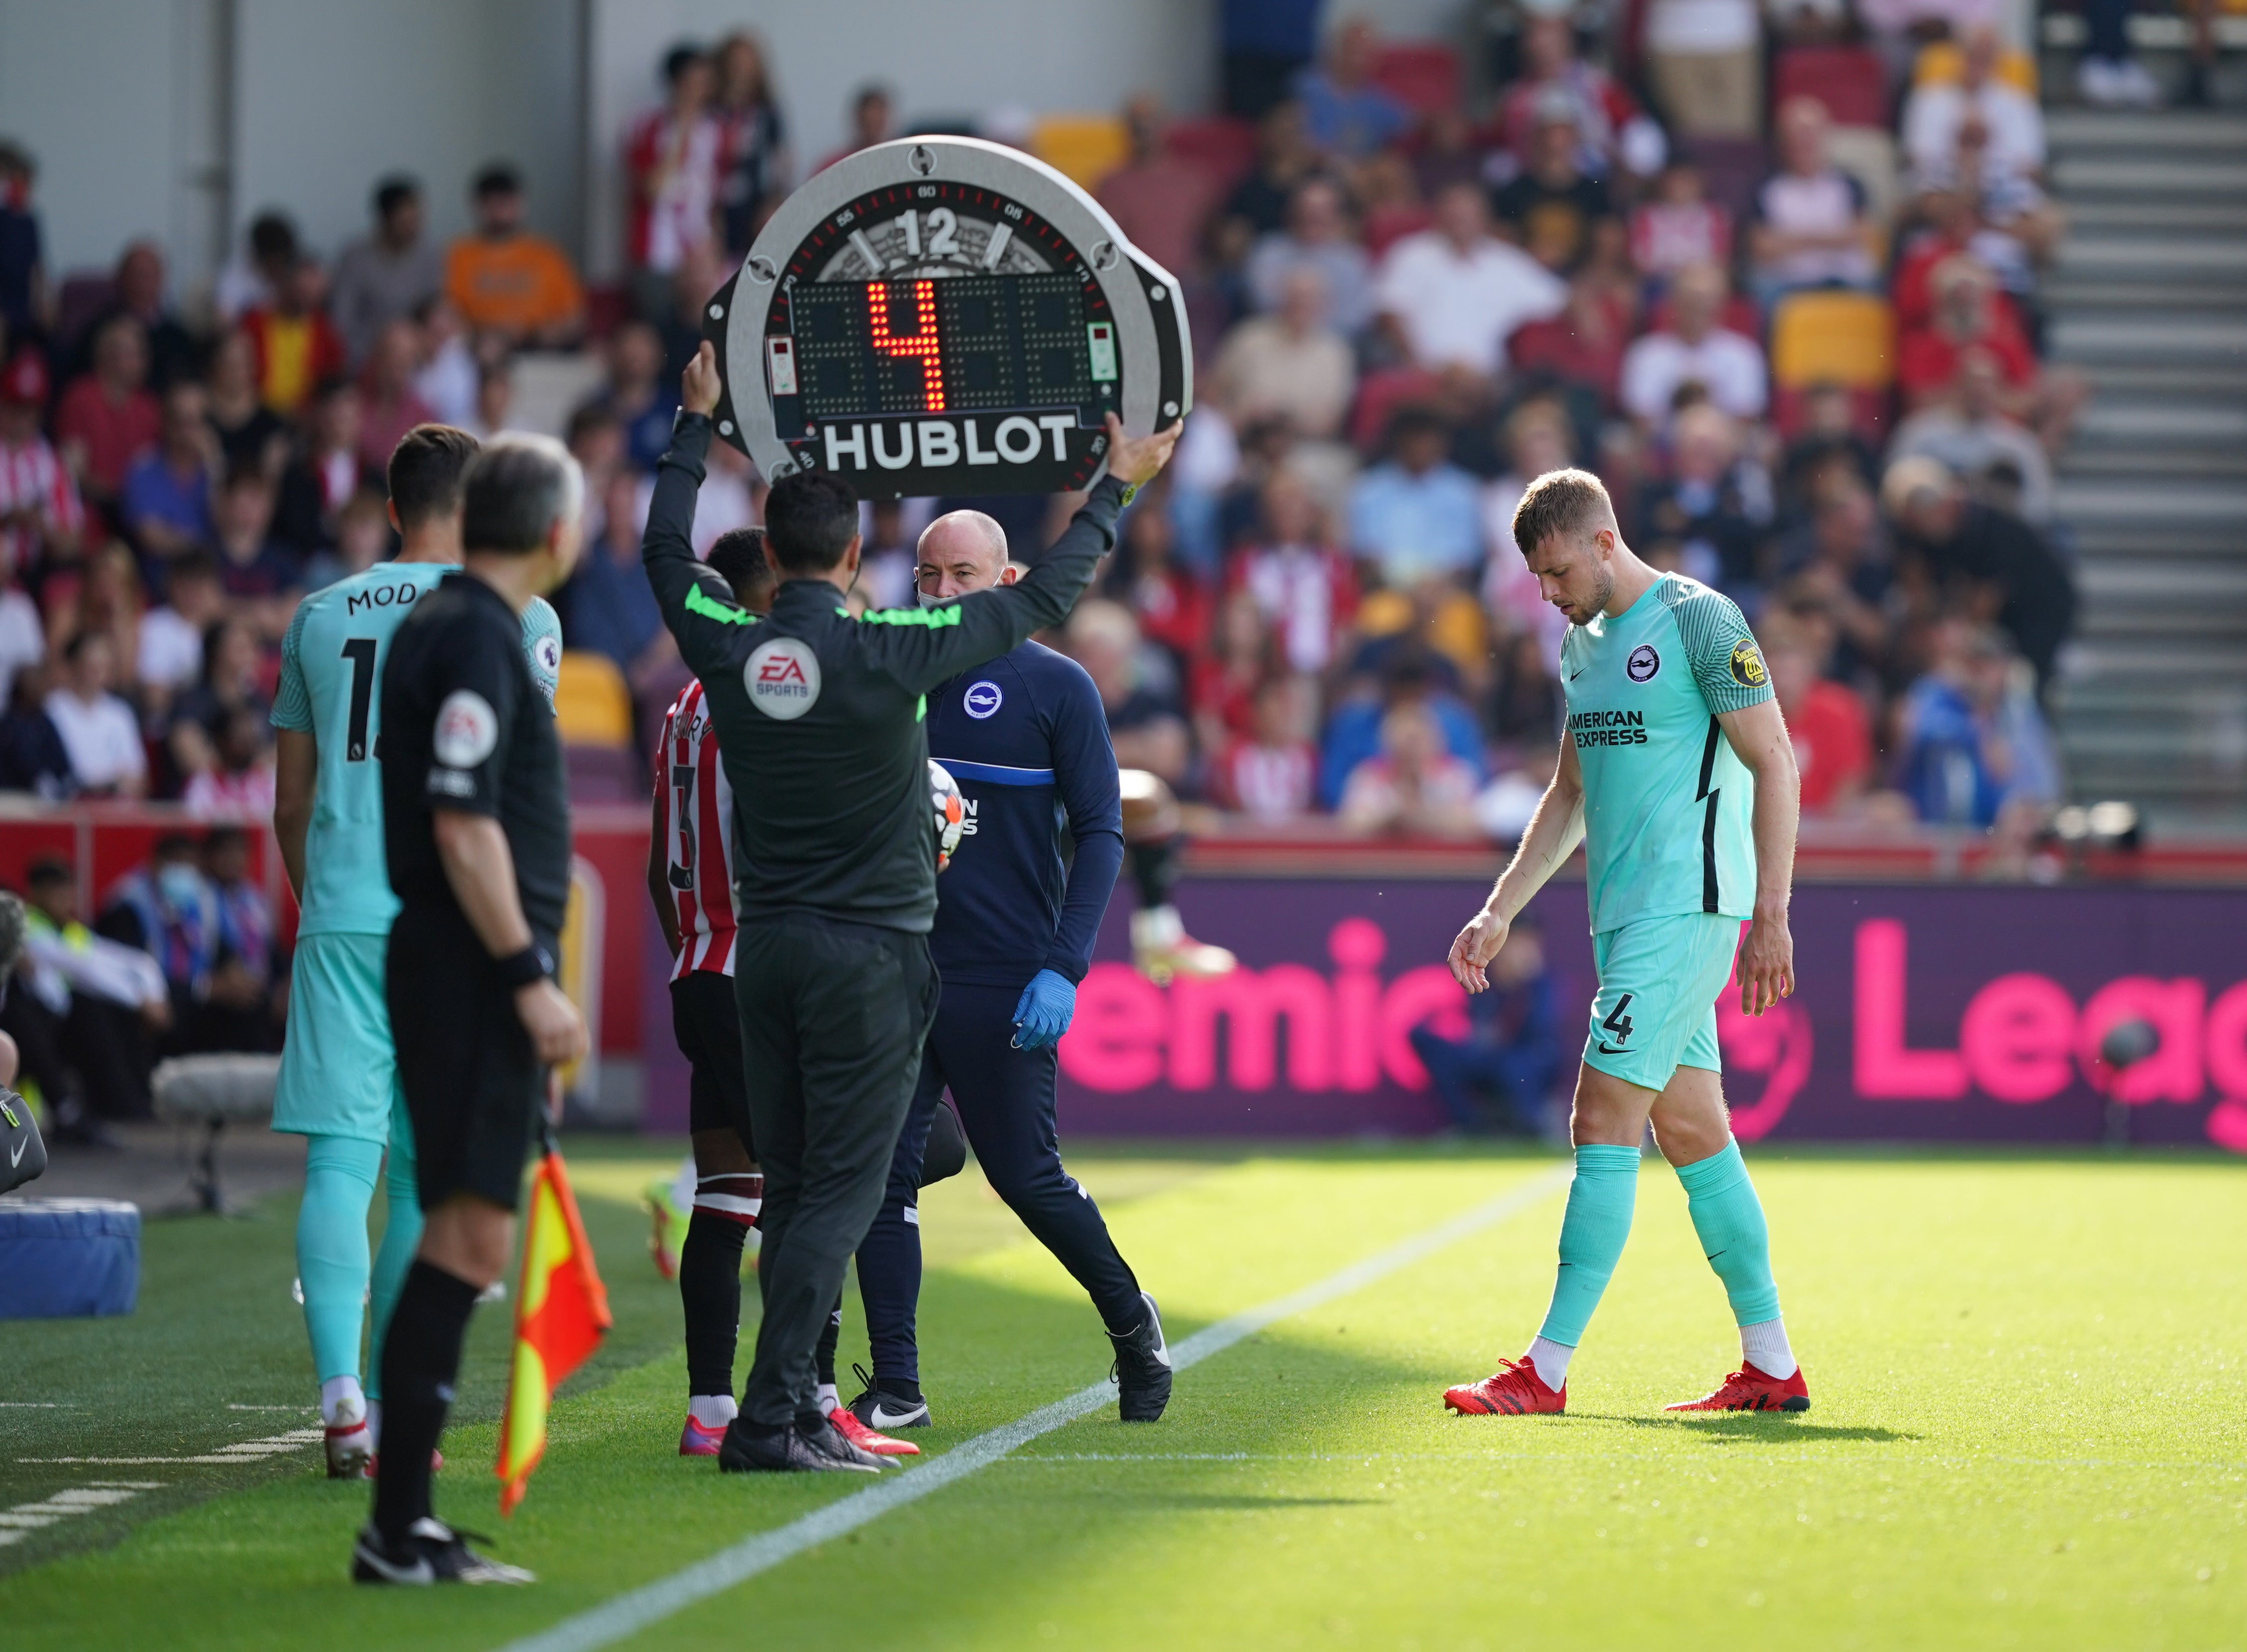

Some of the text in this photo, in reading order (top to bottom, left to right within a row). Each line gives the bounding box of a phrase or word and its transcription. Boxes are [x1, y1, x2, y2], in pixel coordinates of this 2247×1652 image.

[917, 185, 937, 198] 60
[836, 211, 854, 226] 55
[1004, 203, 1023, 220] 05
[895, 207, 960, 257] 12
[867, 280, 944, 412] 4
[824, 414, 1076, 471] HUBLOT
[347, 583, 432, 616] MOD
[758, 656, 806, 685] EA
[340, 638, 382, 762] 1
[756, 683, 809, 699] SPORTS
[1568, 711, 1644, 730] AMERICAN
[1575, 728, 1648, 748] EXPRESS
[668, 765, 696, 891] 3
[1602, 992, 1635, 1046] 4
